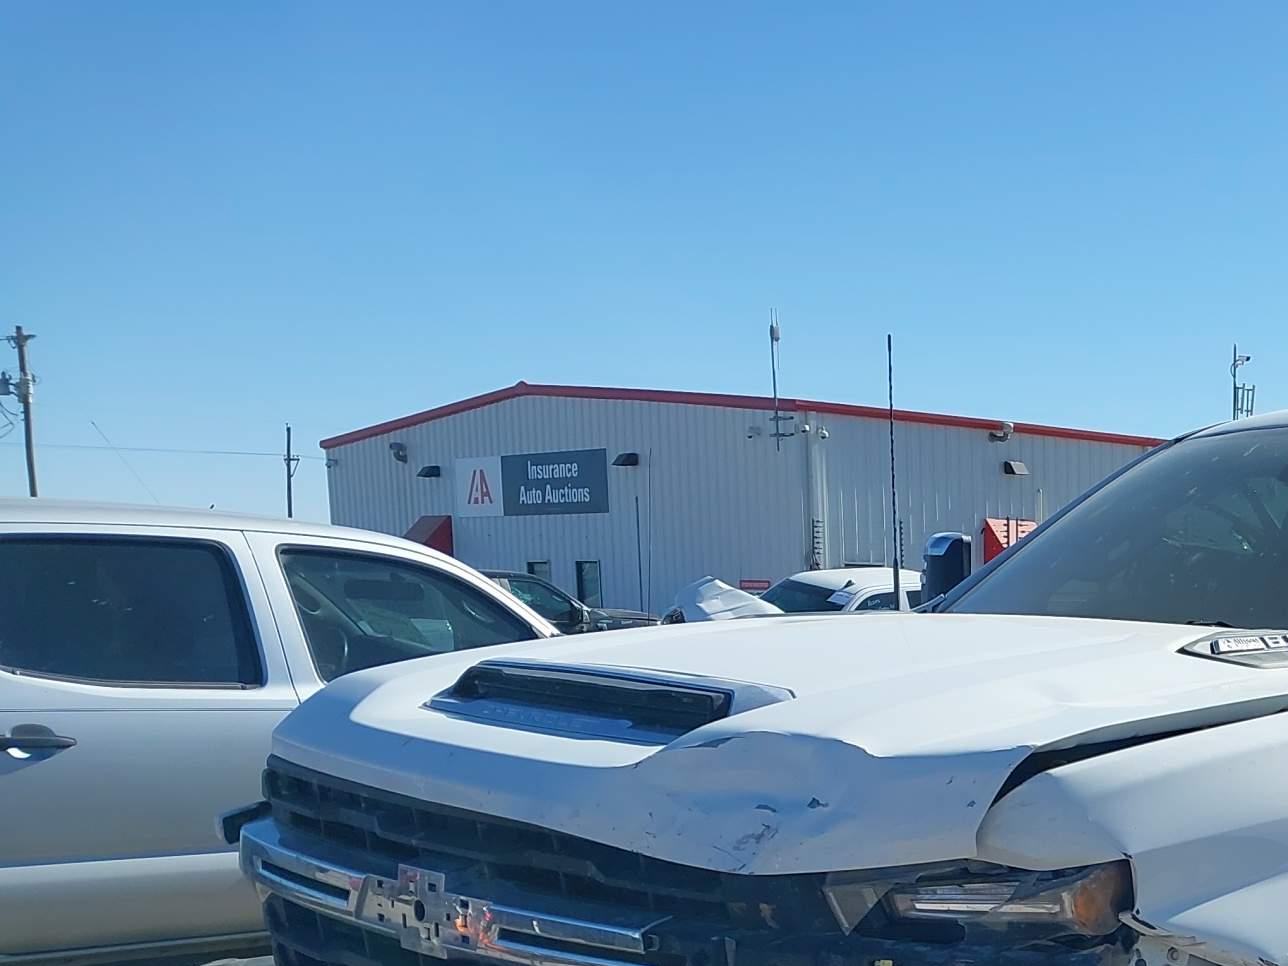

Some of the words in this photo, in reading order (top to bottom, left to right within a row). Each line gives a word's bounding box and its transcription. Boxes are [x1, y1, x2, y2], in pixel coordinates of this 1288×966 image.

[527, 460, 579, 480] Insurance
[519, 485, 542, 505] Auto
[545, 483, 590, 504] Auctions
